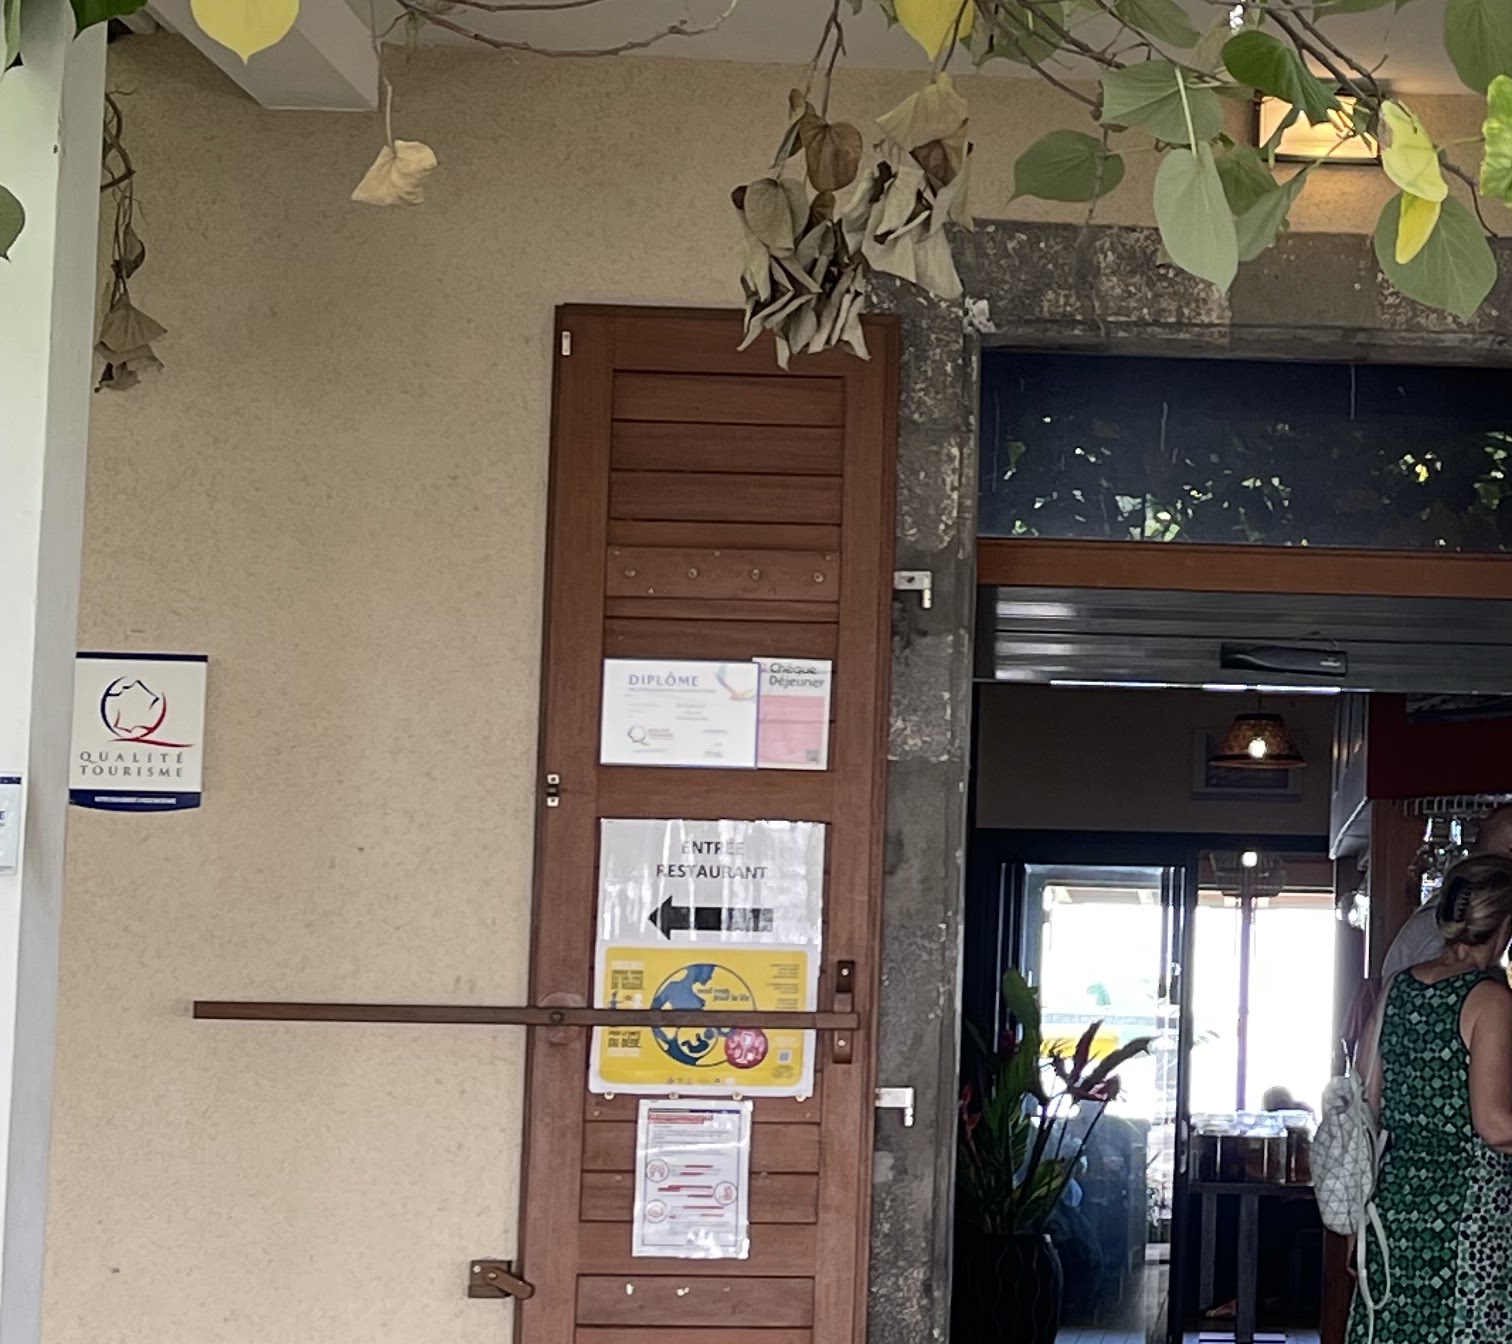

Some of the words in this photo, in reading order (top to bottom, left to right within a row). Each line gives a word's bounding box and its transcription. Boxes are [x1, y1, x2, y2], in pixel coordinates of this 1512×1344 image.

[628, 672, 700, 687] DIPLÔME
[768, 675, 826, 690] Déjeuner
[80, 751, 184, 764] QUALITÉ
[80, 765, 184, 777] TOURISME
[656, 864, 769, 880] RESTAURANT
